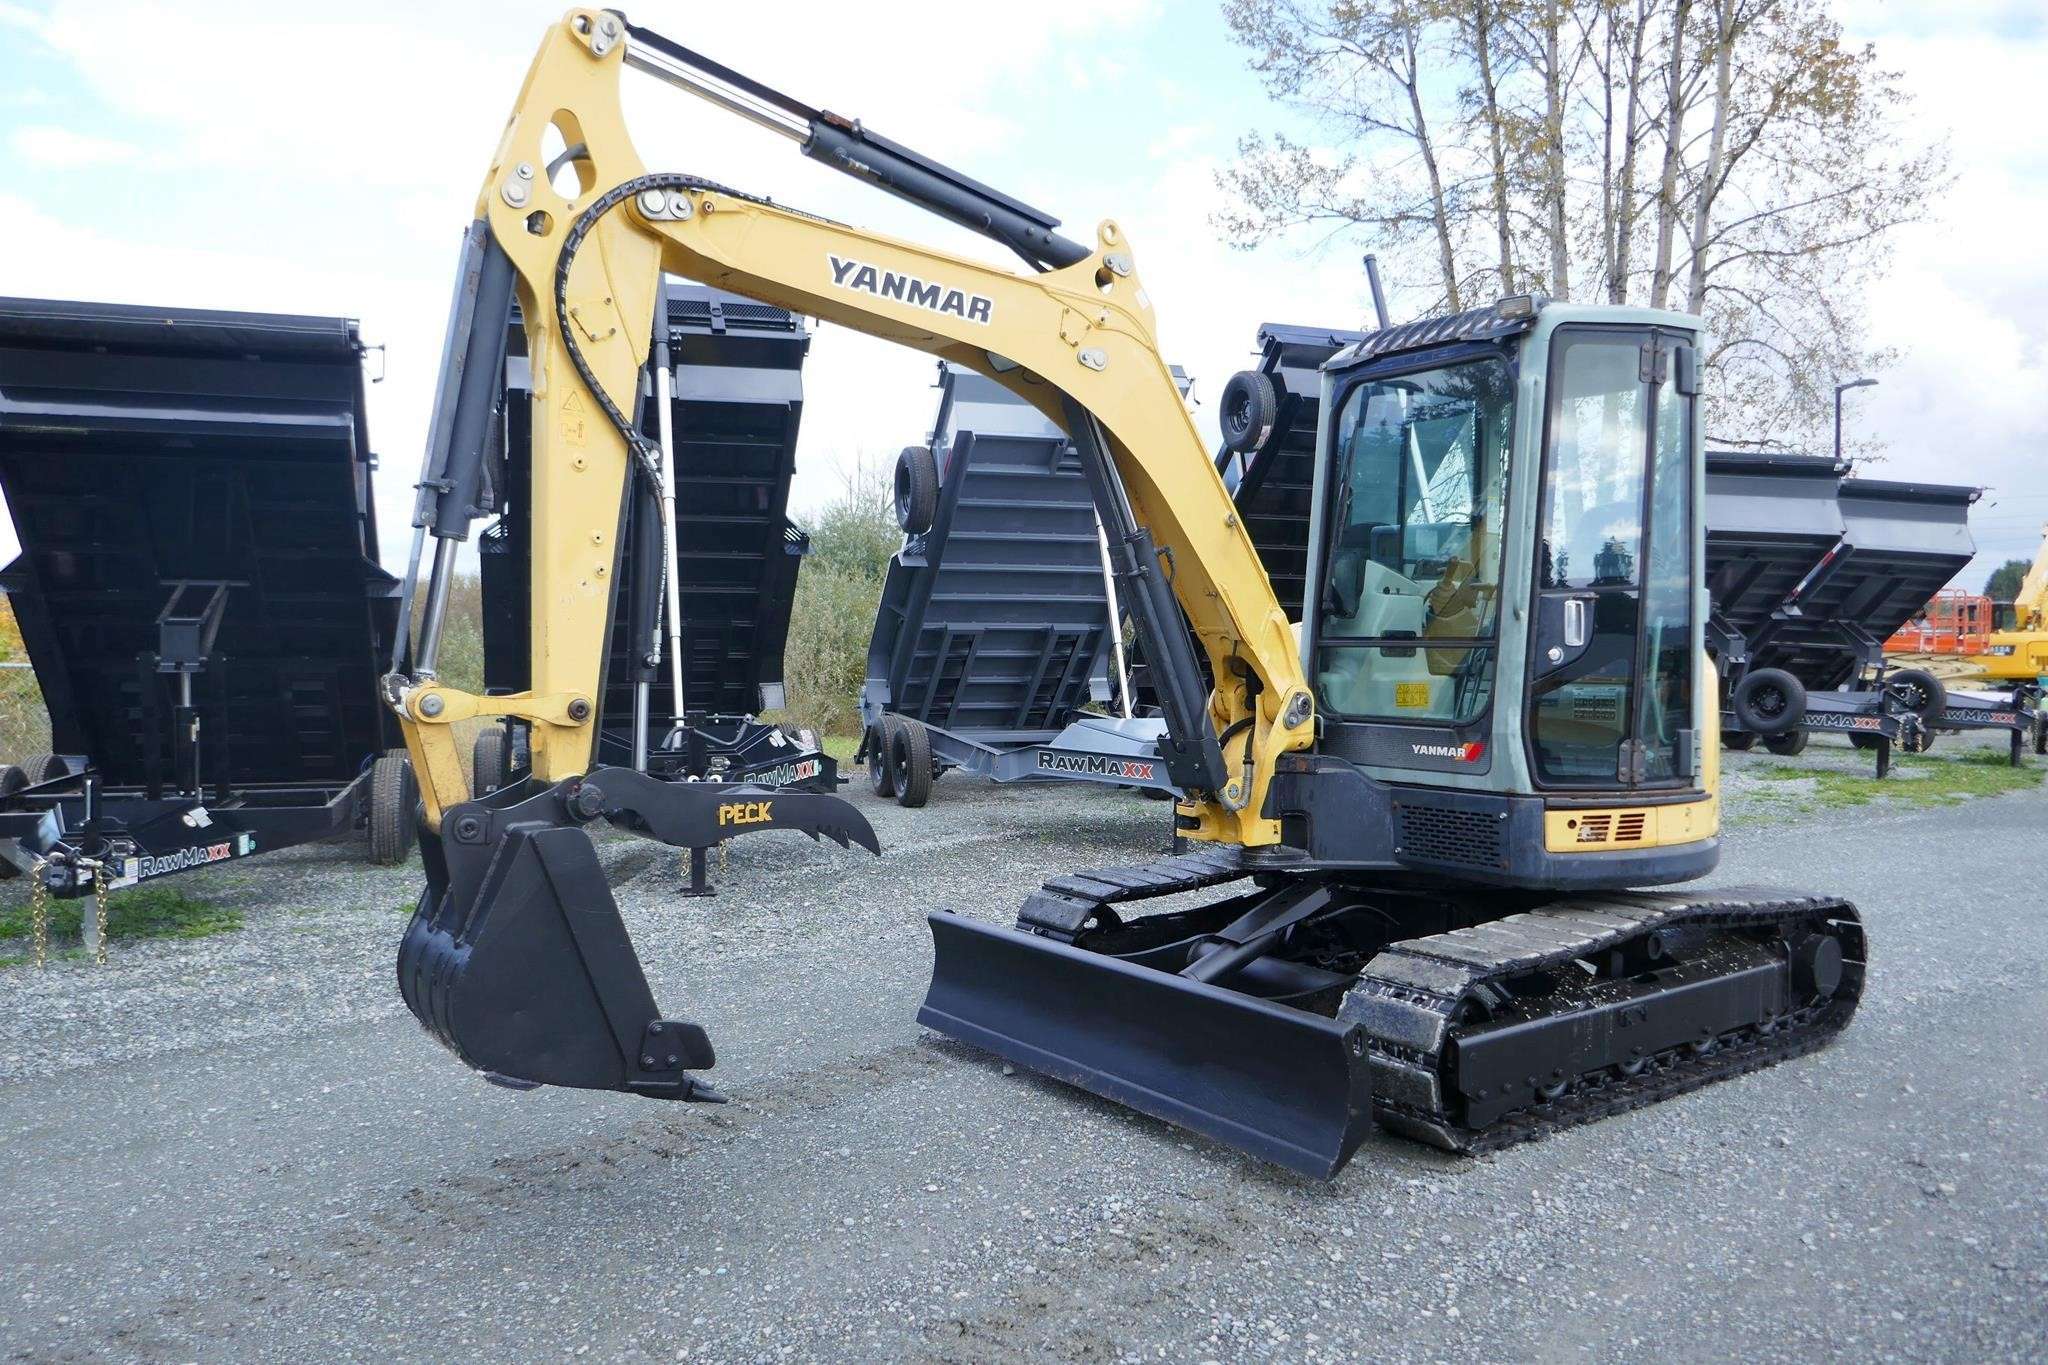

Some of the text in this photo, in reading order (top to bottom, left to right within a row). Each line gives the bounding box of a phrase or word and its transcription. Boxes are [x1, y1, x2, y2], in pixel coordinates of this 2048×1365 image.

[828, 254, 993, 325] YANMAR
[1800, 714, 1881, 730] AWMAXX
[1412, 745, 1466, 757] YANMAR
[719, 801, 772, 825] PECK
